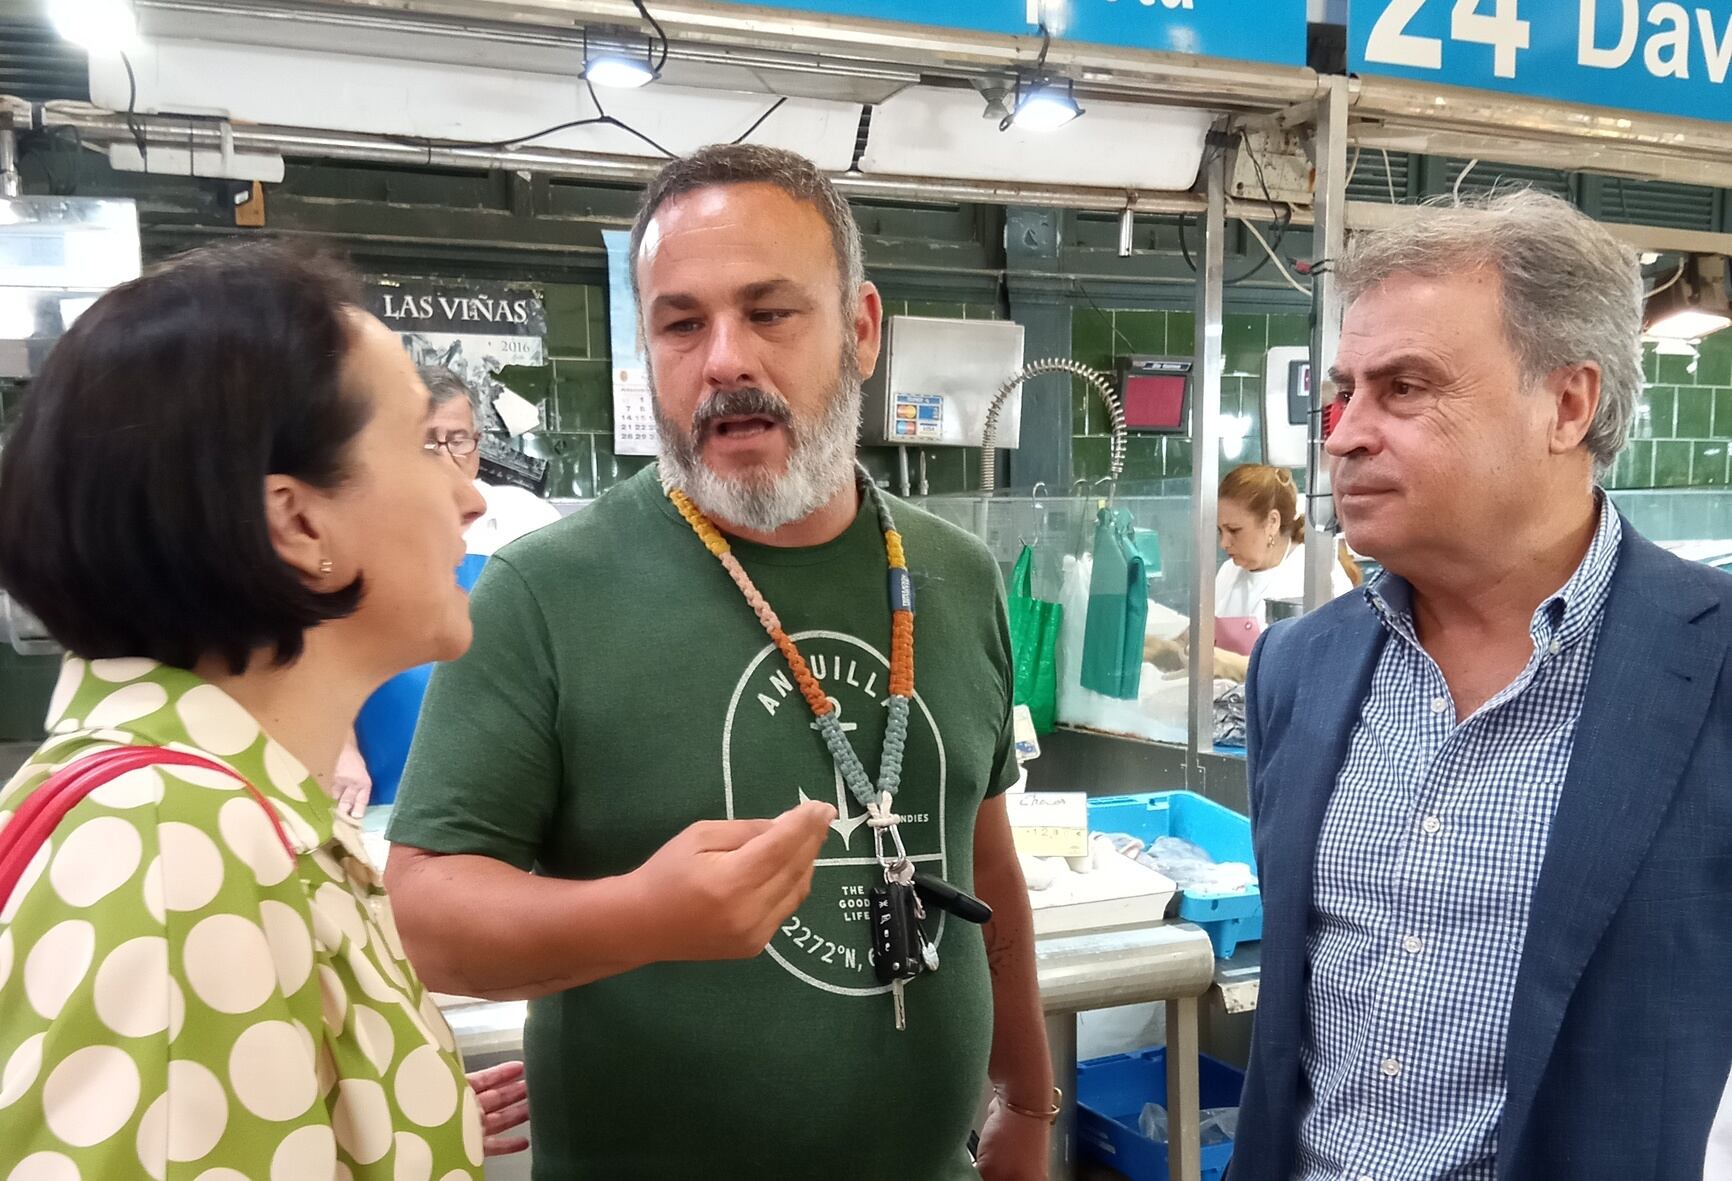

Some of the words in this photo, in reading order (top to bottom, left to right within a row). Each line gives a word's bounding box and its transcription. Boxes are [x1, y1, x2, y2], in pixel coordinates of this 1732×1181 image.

[1364, 0, 1529, 78] 24
[383, 294, 434, 320] LAS
[437, 293, 528, 325] VIÑAS
[502, 340, 531, 353] 2016
[757, 654, 890, 717] ANUILL
[899, 813, 929, 823] NDIES
[842, 886, 865, 895] THE
[838, 899, 871, 909] GOOD
[844, 913, 871, 922] LIFE
